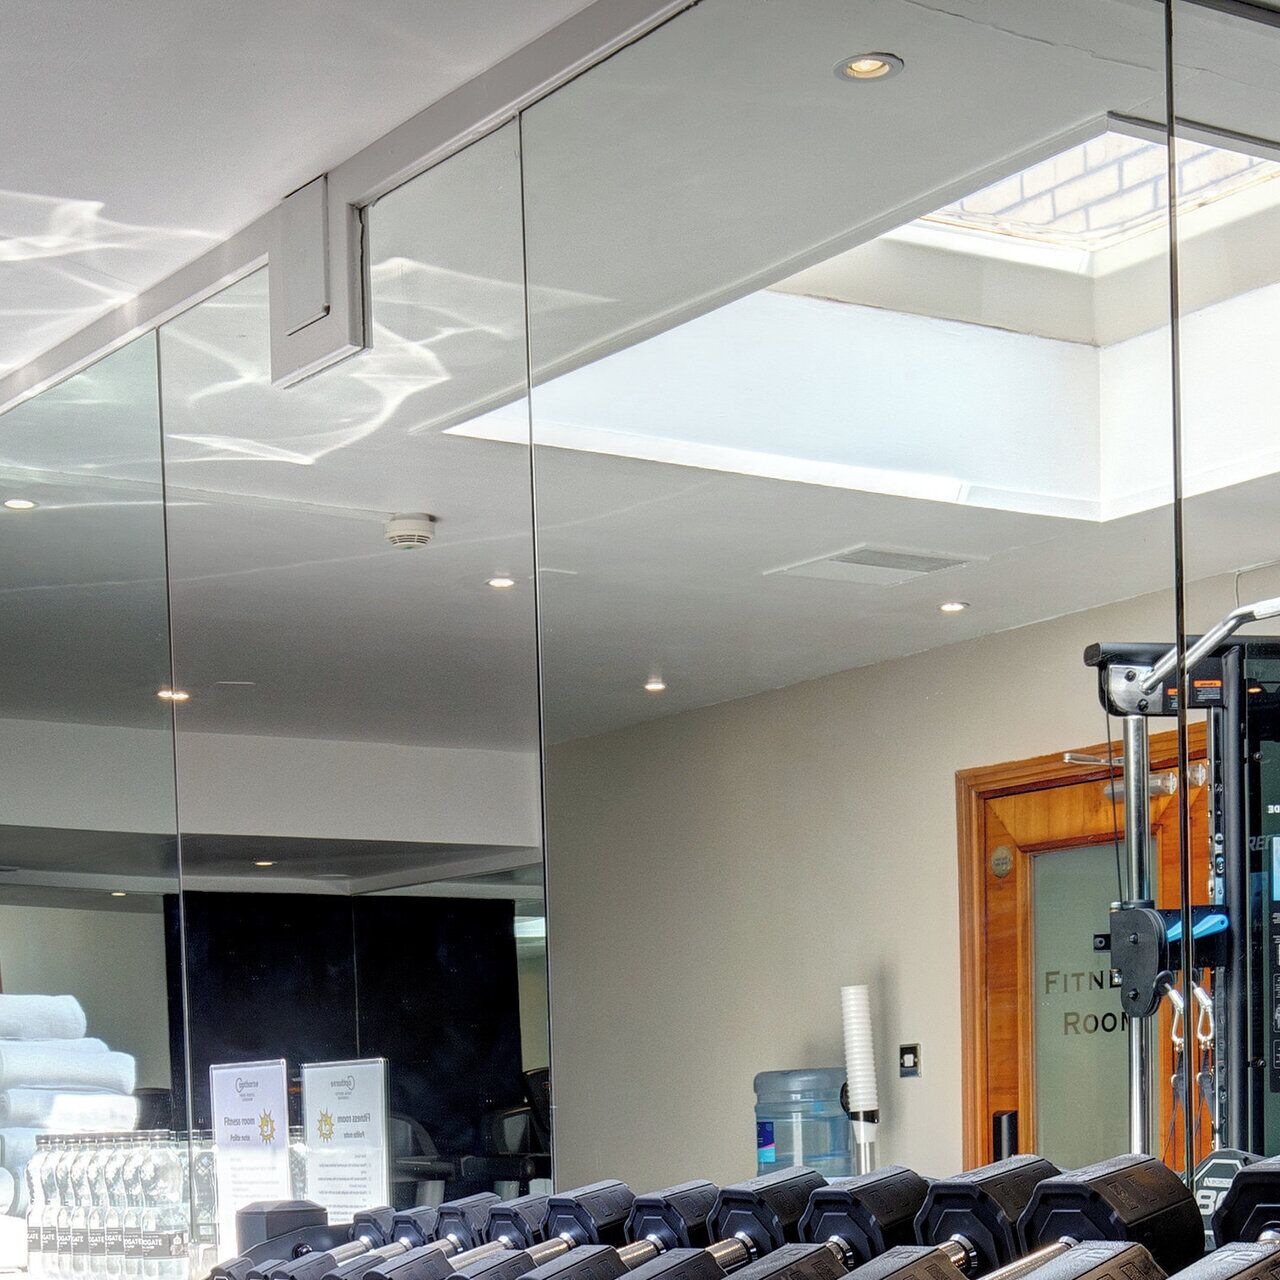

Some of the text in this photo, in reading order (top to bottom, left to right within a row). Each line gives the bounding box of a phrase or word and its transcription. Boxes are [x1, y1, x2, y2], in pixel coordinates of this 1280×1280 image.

[1045, 970, 1122, 994] FITNE
[224, 1117, 255, 1126] Fitness room
